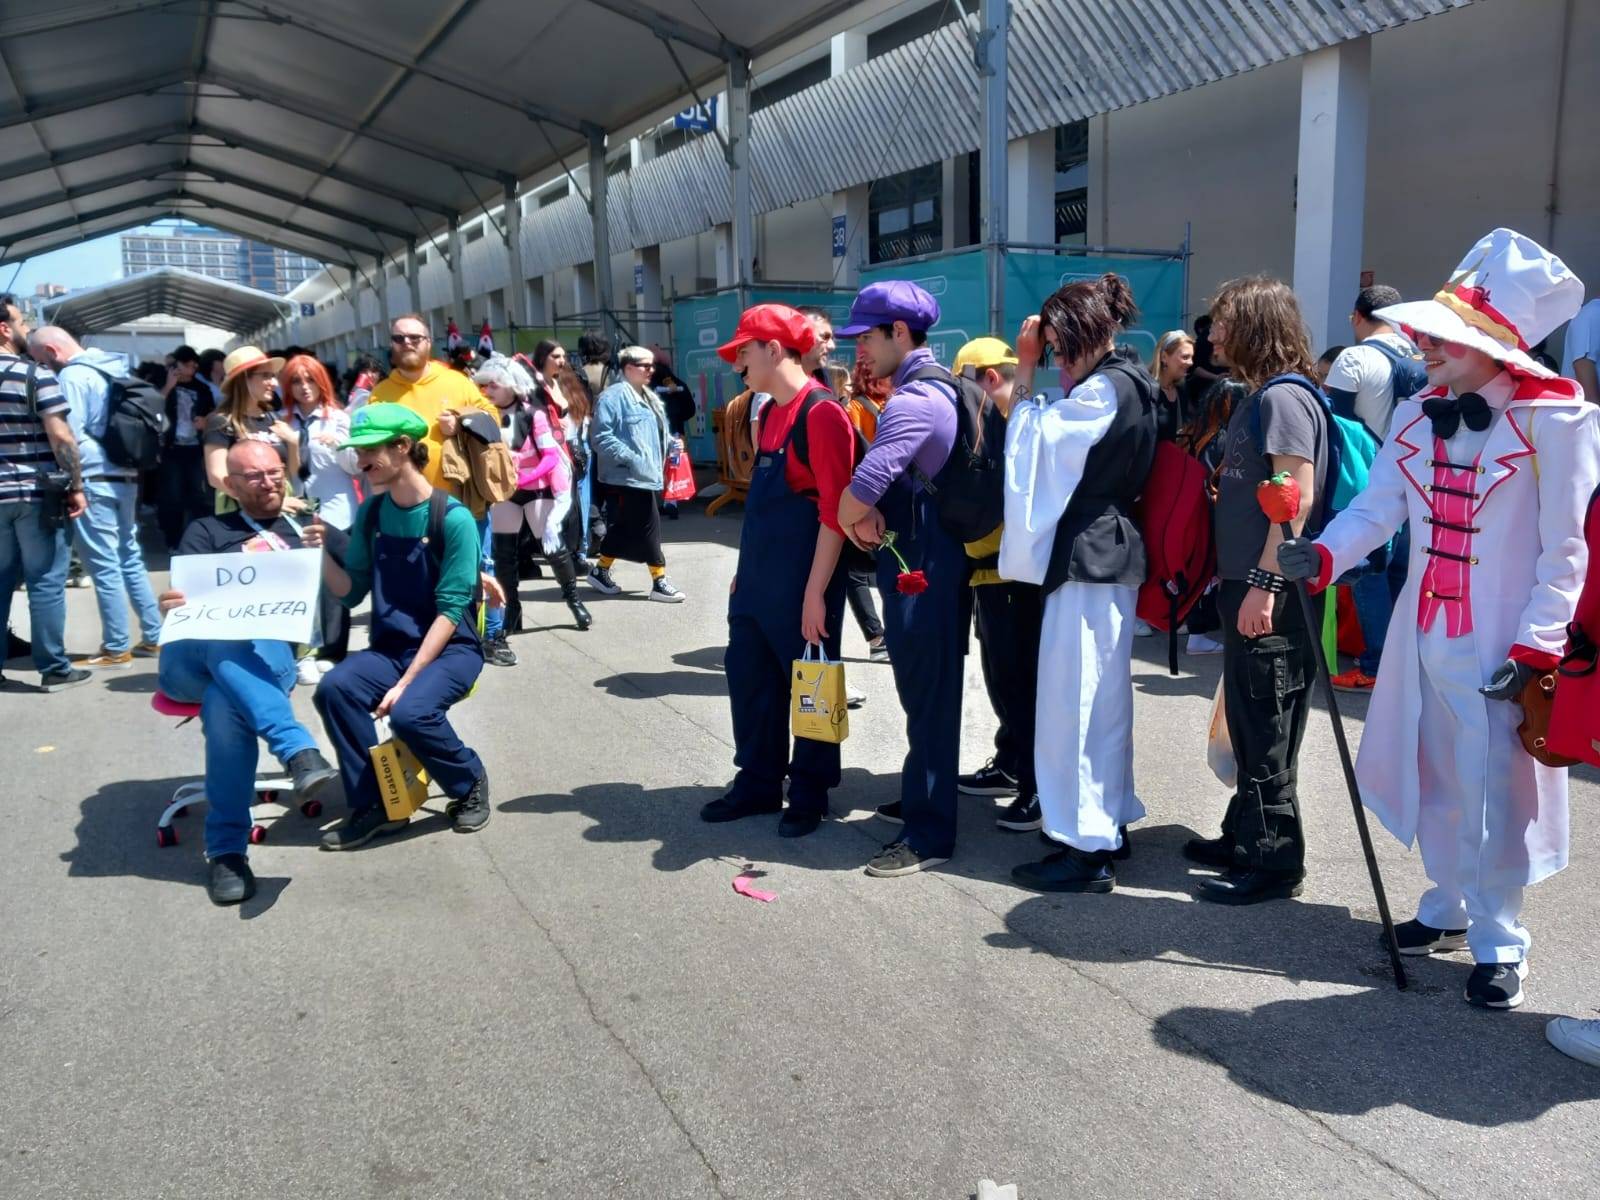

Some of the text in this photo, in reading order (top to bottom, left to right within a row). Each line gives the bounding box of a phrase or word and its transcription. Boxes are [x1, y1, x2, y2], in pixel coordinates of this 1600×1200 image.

[833, 227, 845, 247] 3B
[216, 565, 256, 587] DO
[380, 755, 401, 805] il castoro
